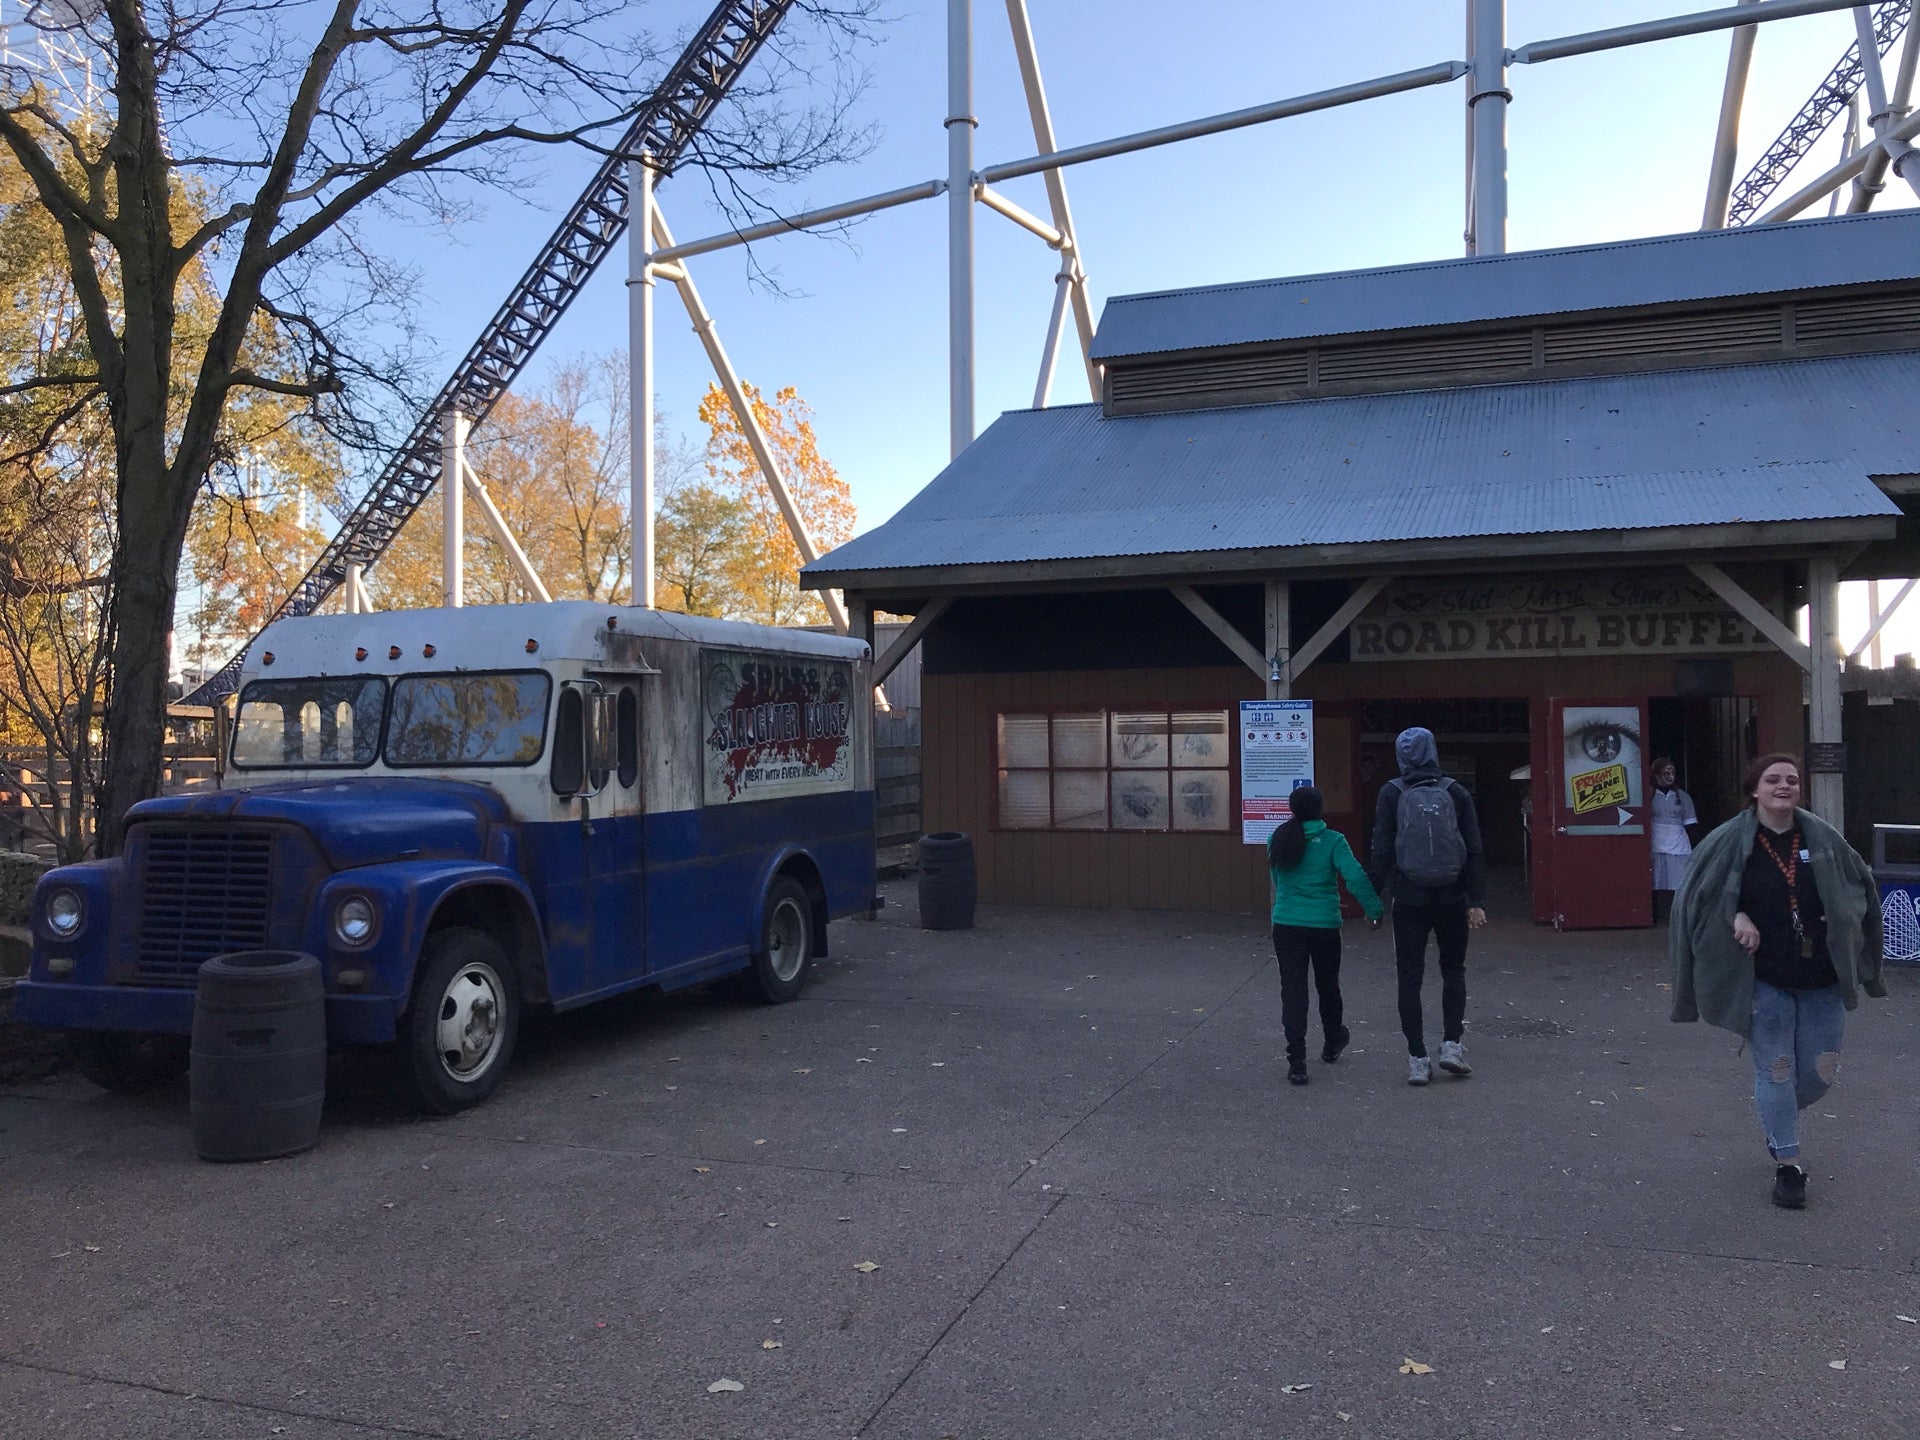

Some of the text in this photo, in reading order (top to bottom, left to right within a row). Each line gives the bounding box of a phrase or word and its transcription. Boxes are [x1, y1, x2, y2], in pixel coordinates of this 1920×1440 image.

[1357, 620, 1477, 655] ROAD
[1486, 615, 1586, 651] KILL
[716, 701, 846, 751] SLAUGHTER HOUSE
[745, 767, 764, 782] MEAT
[781, 767, 801, 780] EVERY
[1575, 768, 1613, 791] FRIGHT
[1579, 776, 1620, 803] LANE
